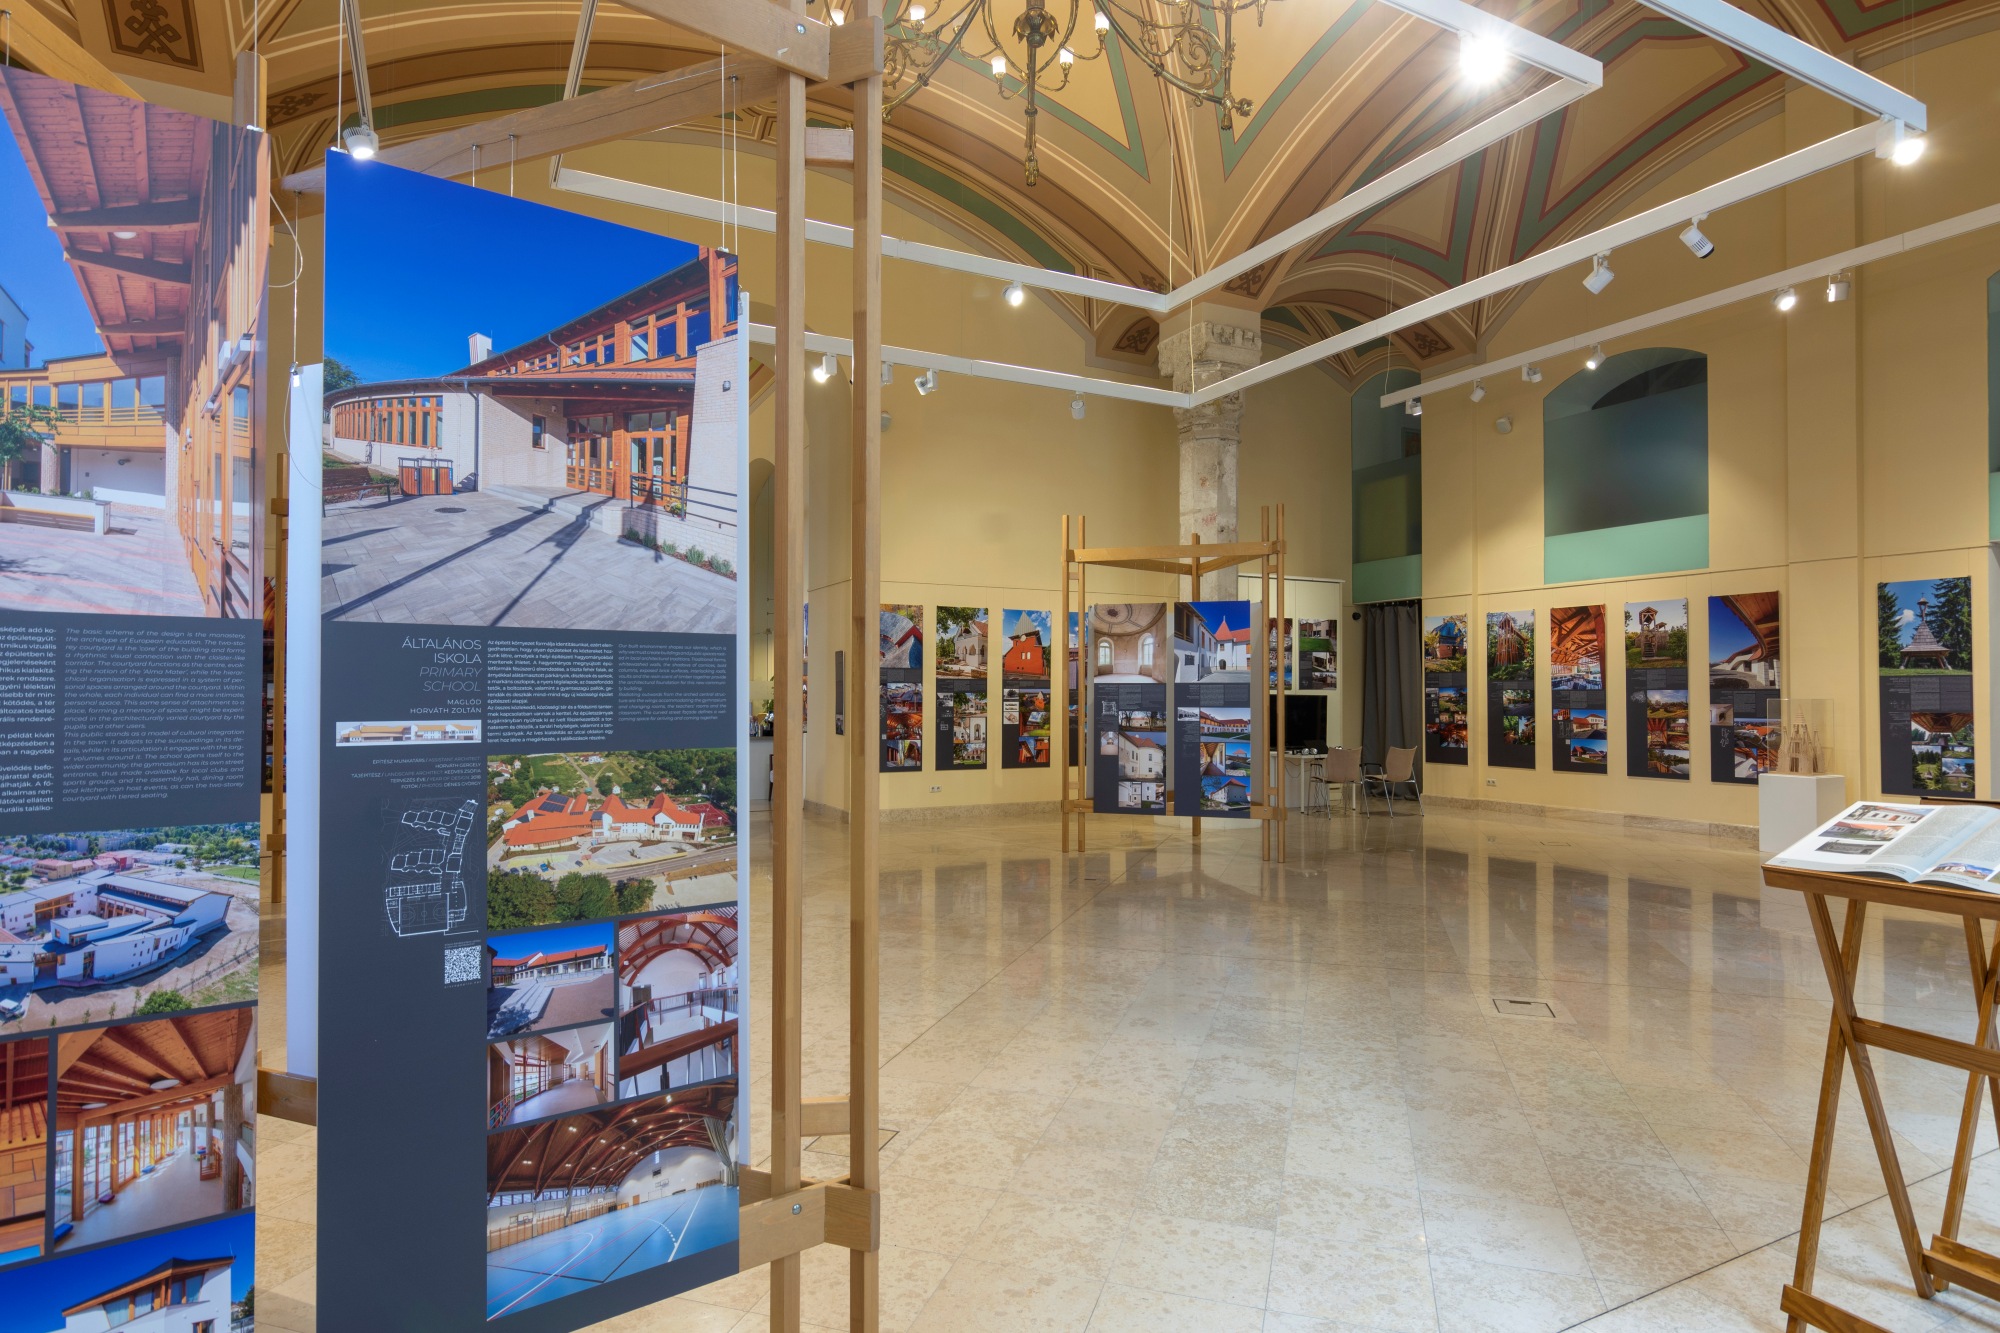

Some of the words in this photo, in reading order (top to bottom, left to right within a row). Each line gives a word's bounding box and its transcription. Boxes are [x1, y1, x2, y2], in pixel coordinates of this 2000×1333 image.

[402, 636, 482, 649] ÁLTALÁNOS
[434, 653, 482, 663] ISKOLA
[420, 666, 483, 677] PRIMARY
[423, 681, 481, 691] SCHOOL
